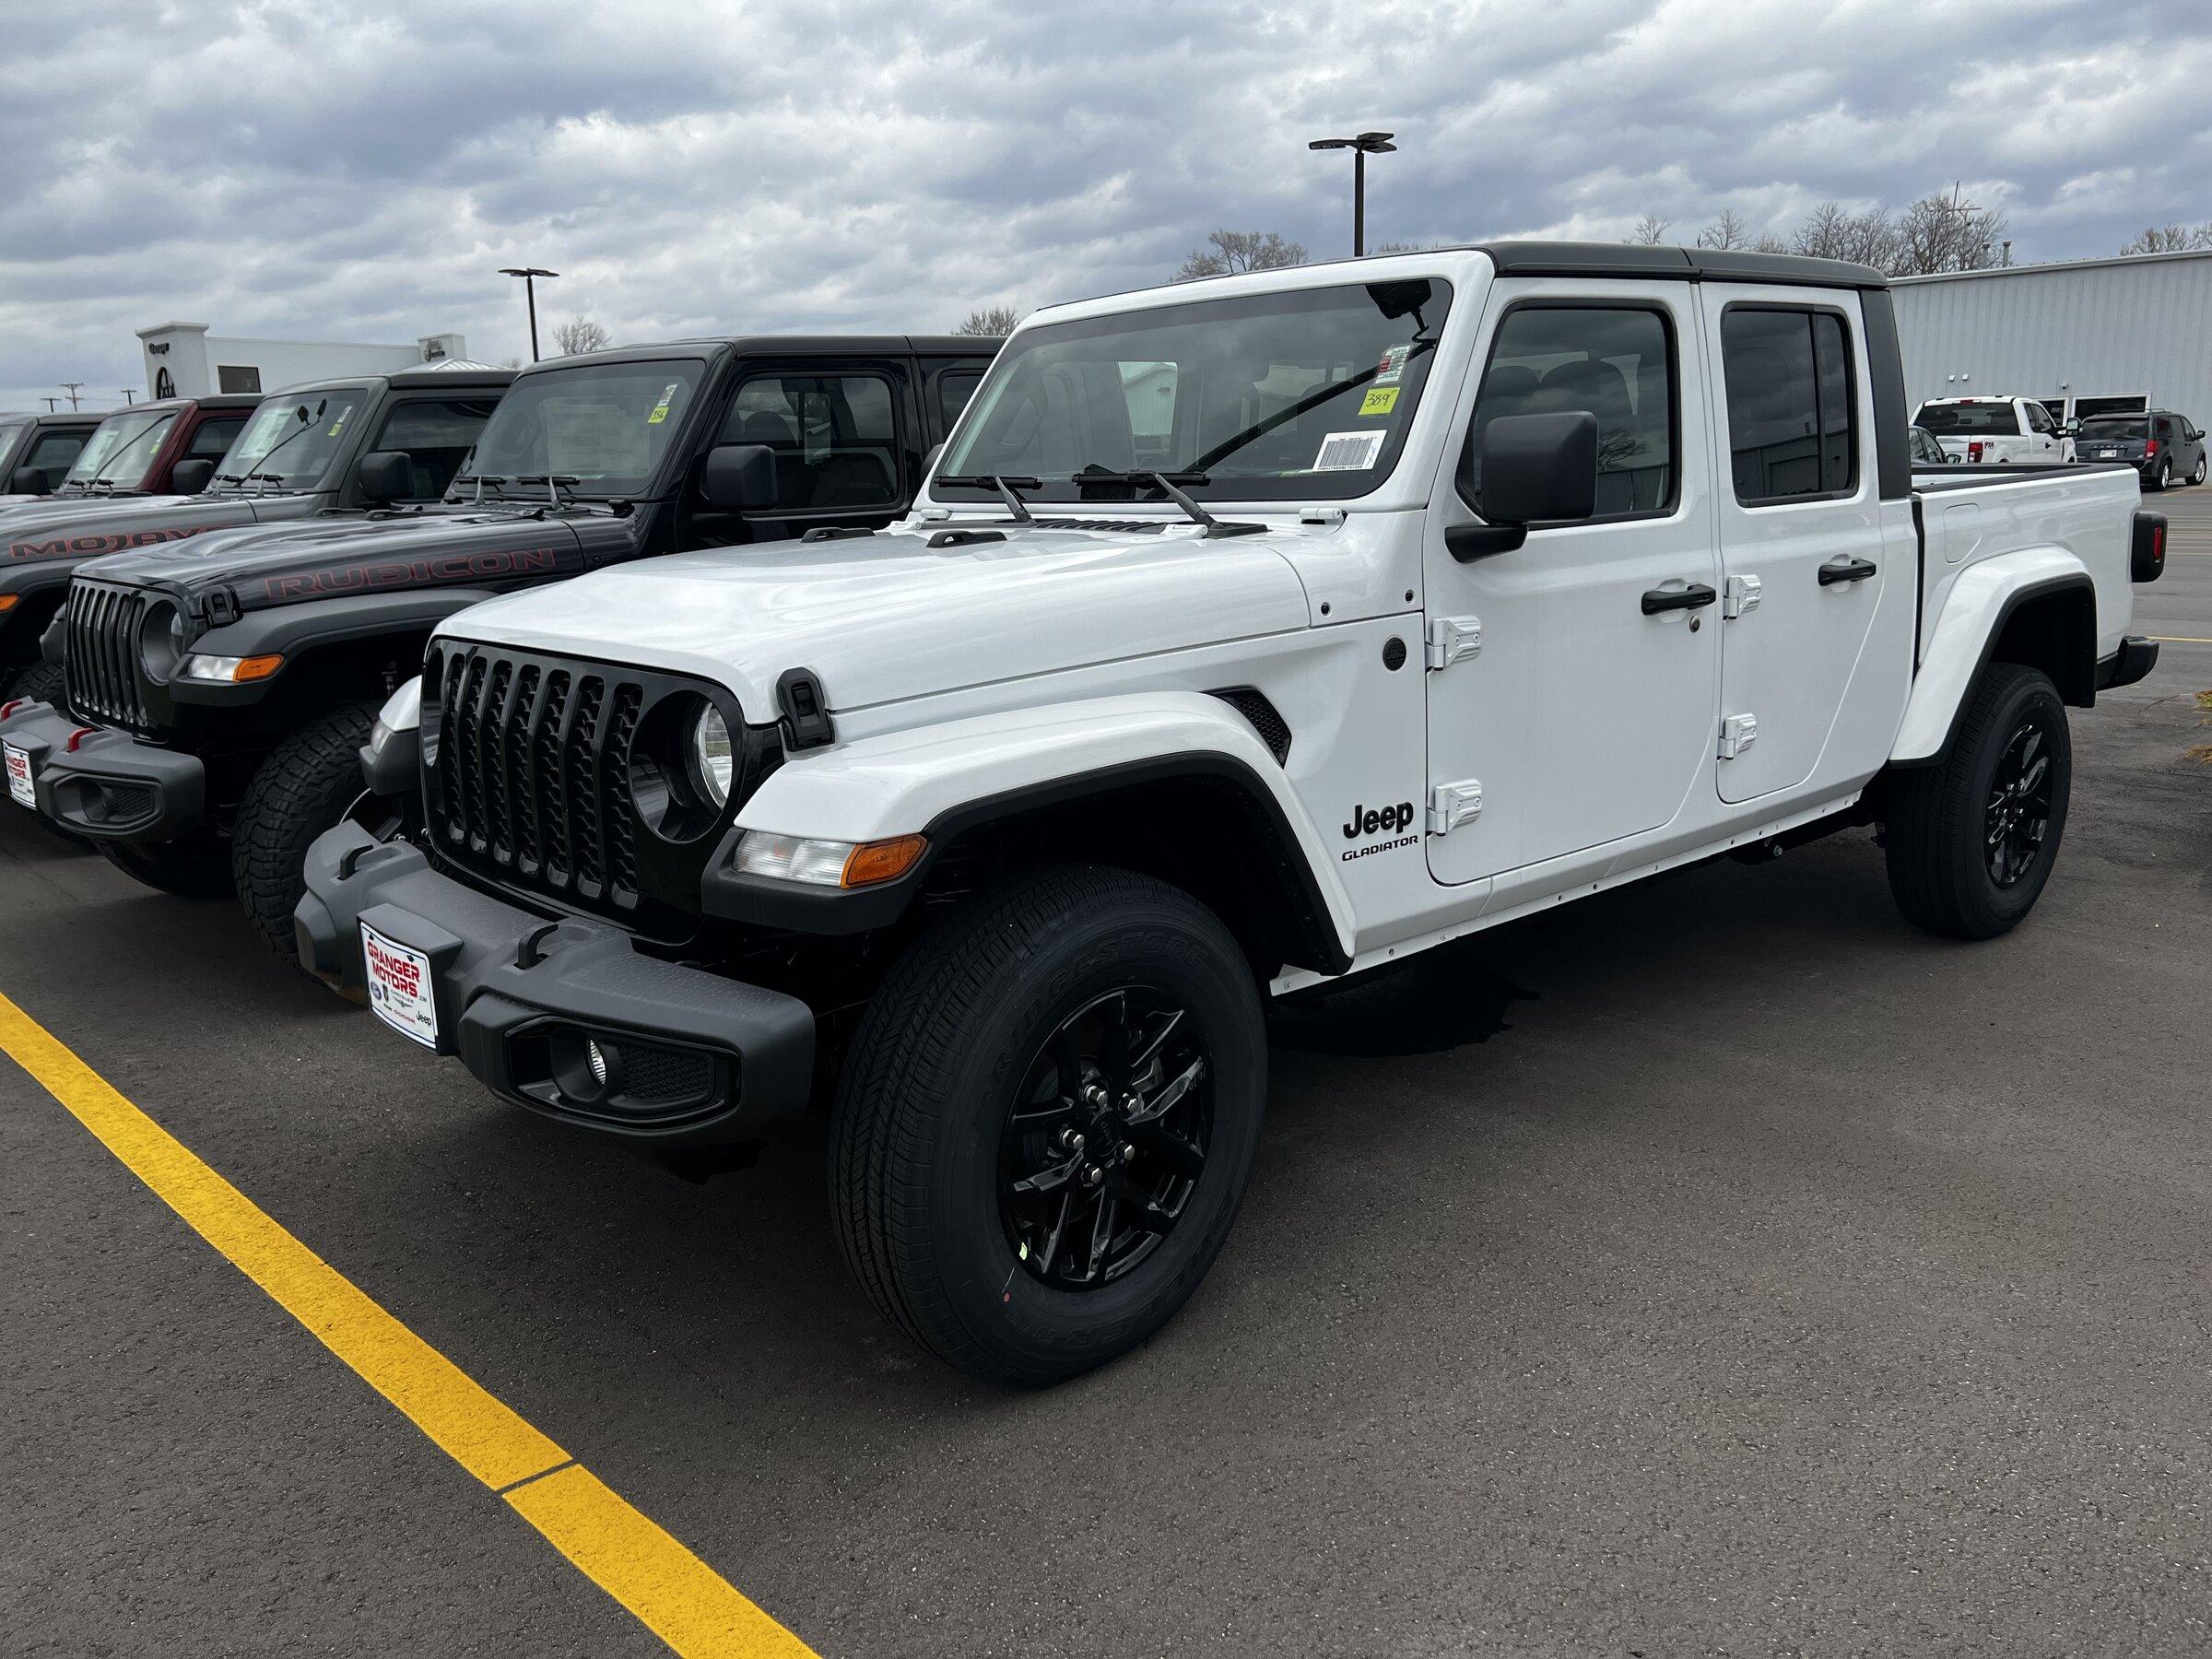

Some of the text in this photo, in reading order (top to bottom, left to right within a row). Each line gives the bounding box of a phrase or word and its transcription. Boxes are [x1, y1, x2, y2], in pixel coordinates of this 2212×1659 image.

[1366, 394, 1390, 406] 389
[10, 524, 239, 559] MOJAV
[264, 547, 557, 599] RUBICON
[1343, 801, 1414, 839] Jeep
[1341, 835, 1419, 862] GLADIATOR
[367, 941, 421, 983] GRANGER
[371, 960, 418, 999] MOTORS
[417, 1011, 431, 1027] Jeep
